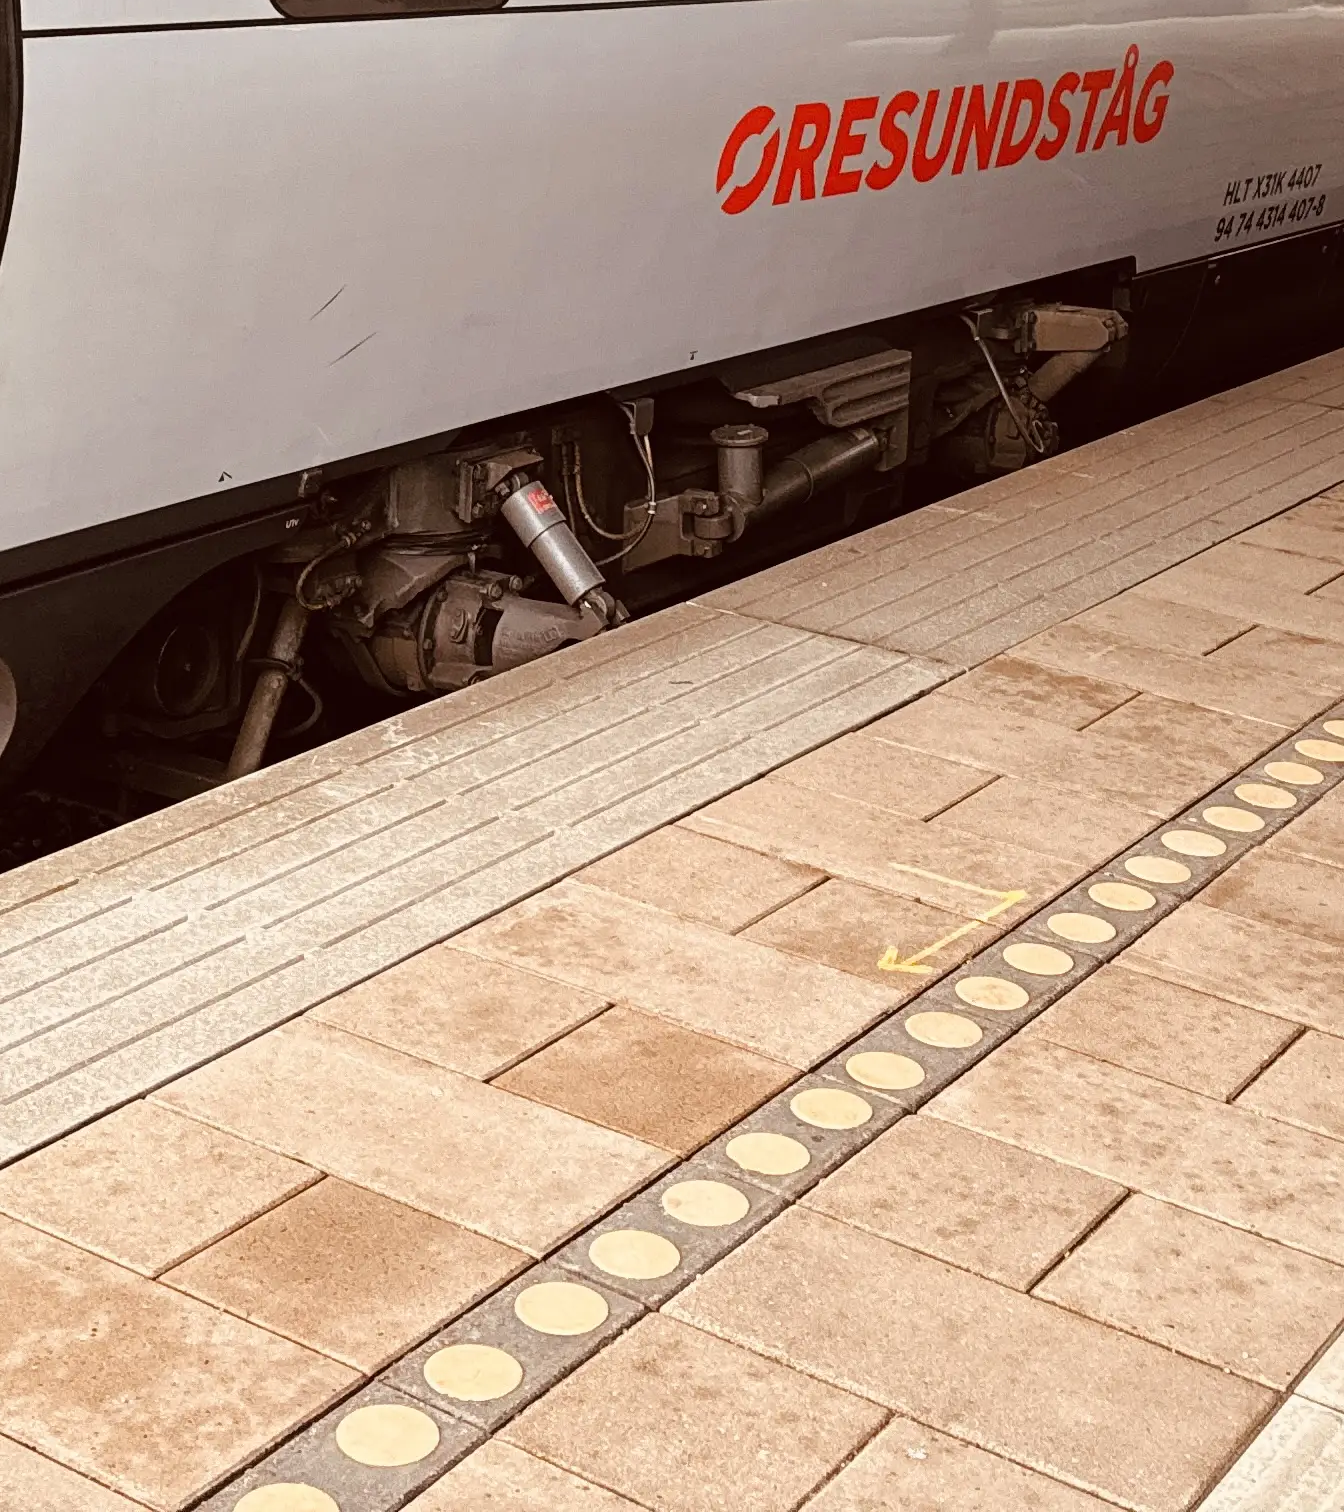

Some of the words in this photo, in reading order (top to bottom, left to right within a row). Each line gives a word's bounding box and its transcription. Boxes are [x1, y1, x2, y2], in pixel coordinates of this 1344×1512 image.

[1223, 178, 1254, 207] HLT
[1252, 171, 1287, 200] X31K
[1287, 164, 1323, 191] 4407
[1214, 215, 1235, 242] 94
[1235, 210, 1255, 237] 74
[1256, 203, 1288, 231] 4314
[1288, 194, 1327, 223] 407-8
